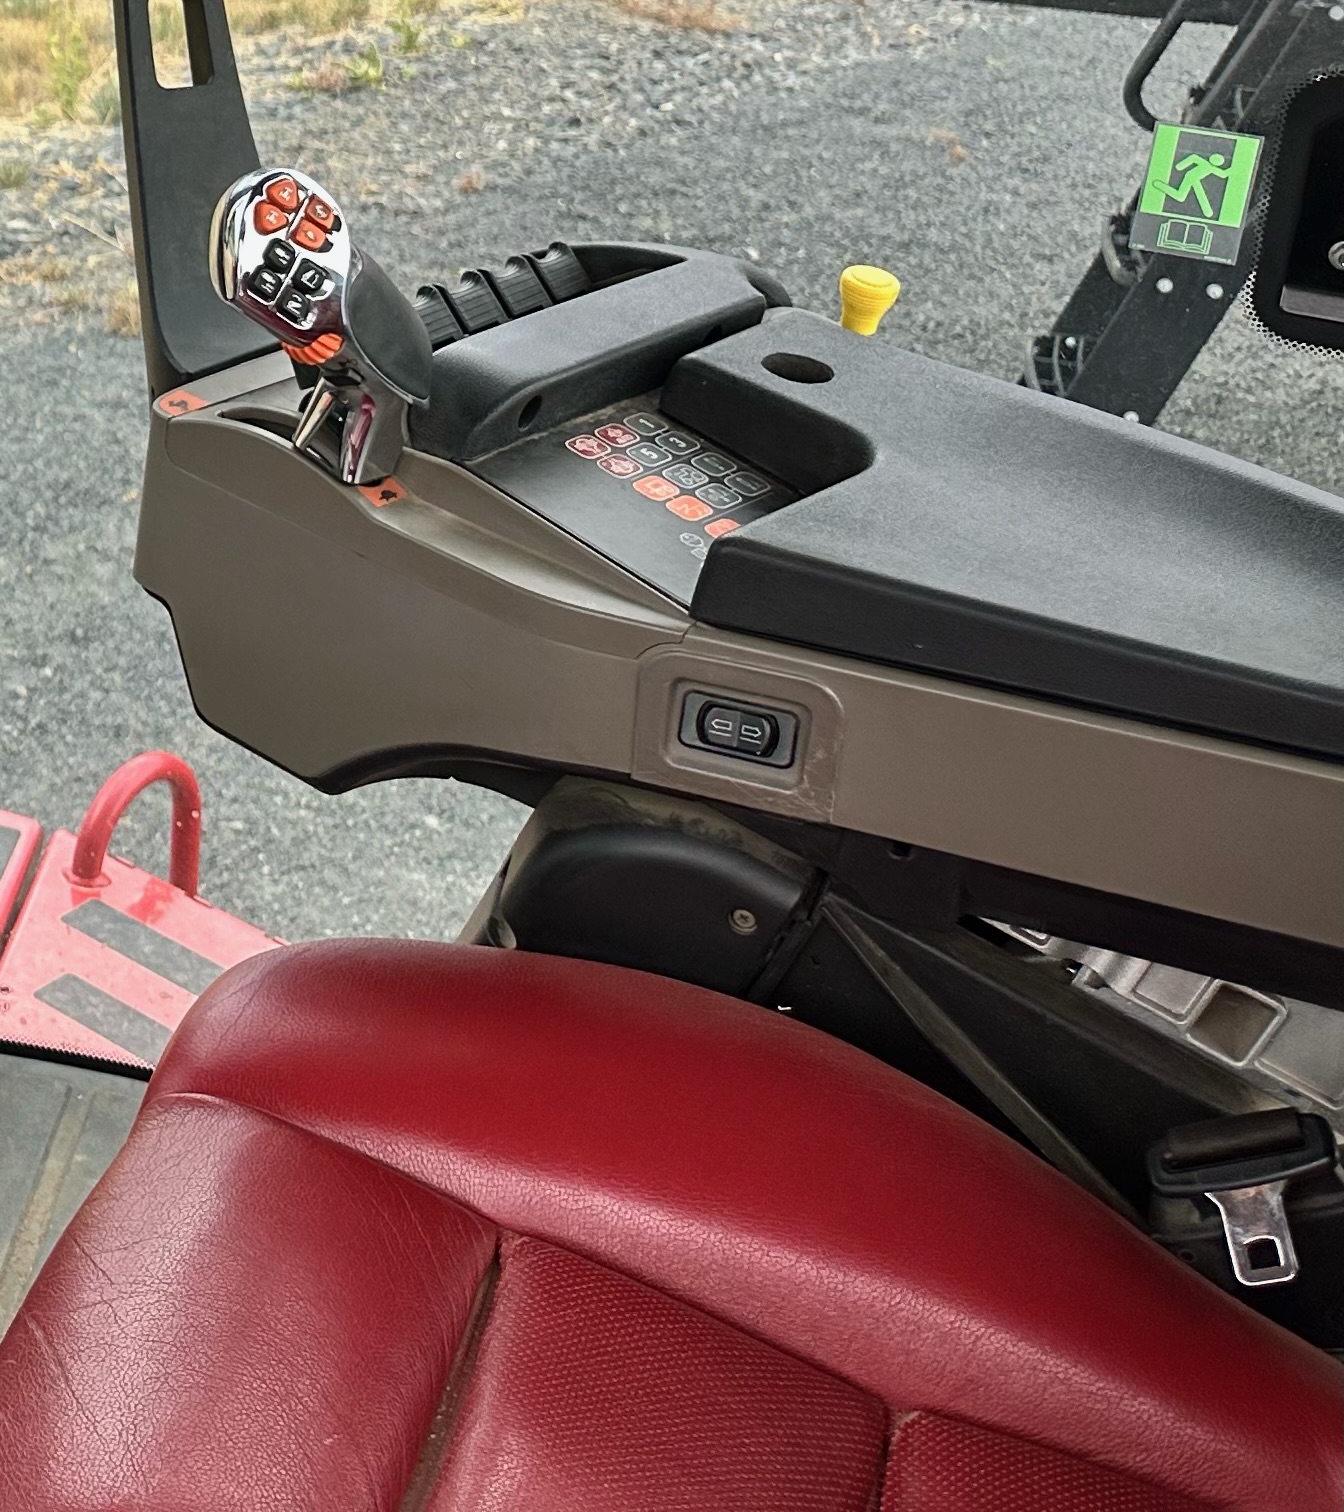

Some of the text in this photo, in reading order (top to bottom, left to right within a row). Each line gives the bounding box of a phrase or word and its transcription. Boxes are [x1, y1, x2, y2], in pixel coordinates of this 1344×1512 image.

[638, 418, 654, 428] 1
[669, 437, 687, 448] 3
[640, 448, 658, 459] 5
